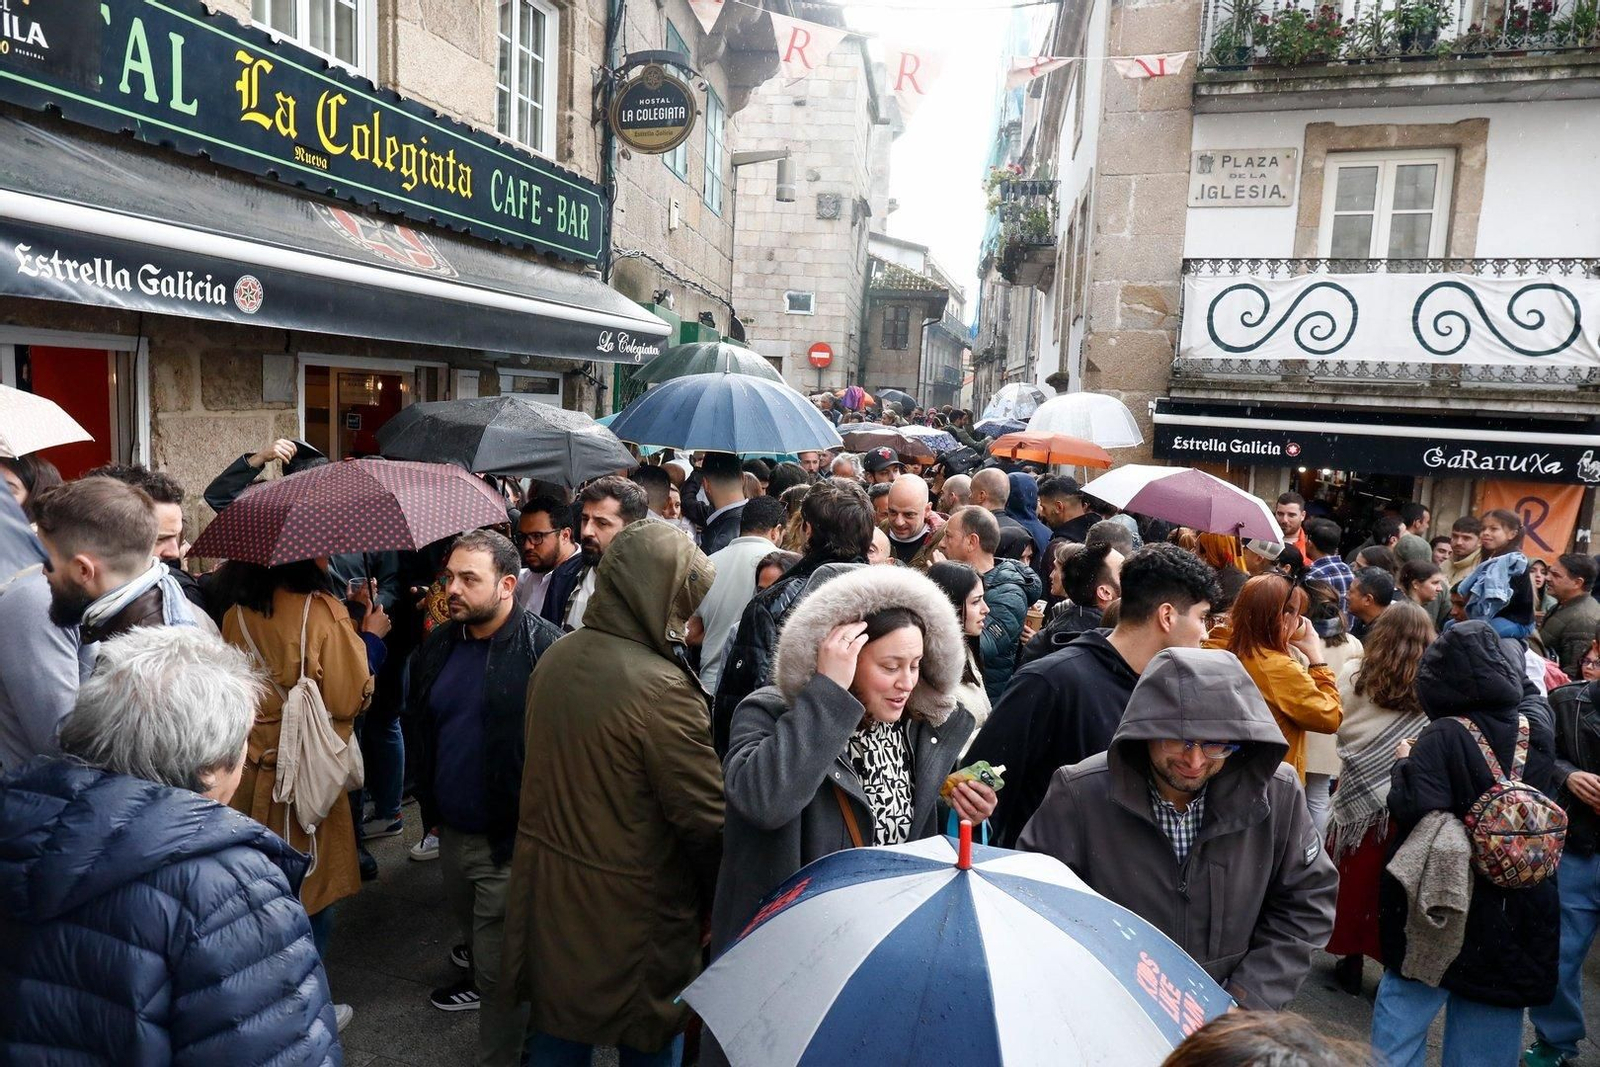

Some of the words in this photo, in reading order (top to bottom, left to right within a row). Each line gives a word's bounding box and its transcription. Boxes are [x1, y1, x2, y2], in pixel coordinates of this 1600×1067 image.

[99, 3, 198, 116] AL
[783, 26, 814, 70] R
[894, 51, 926, 95] R
[622, 110, 633, 122] LA
[636, 106, 686, 122] COLEGIATA
[639, 97, 671, 105] HOSTAL
[235, 50, 298, 139] La
[316, 90, 473, 199] Colegiata
[294, 145, 328, 170] Nueva
[1221, 155, 1279, 168] PLAZA
[14, 243, 132, 292] Estrella
[138, 263, 227, 305] Galicia
[596, 330, 615, 353] La
[617, 332, 660, 362] Colegiata
[1172, 435, 1227, 453] Estrella
[1230, 438, 1281, 455] Galicia
